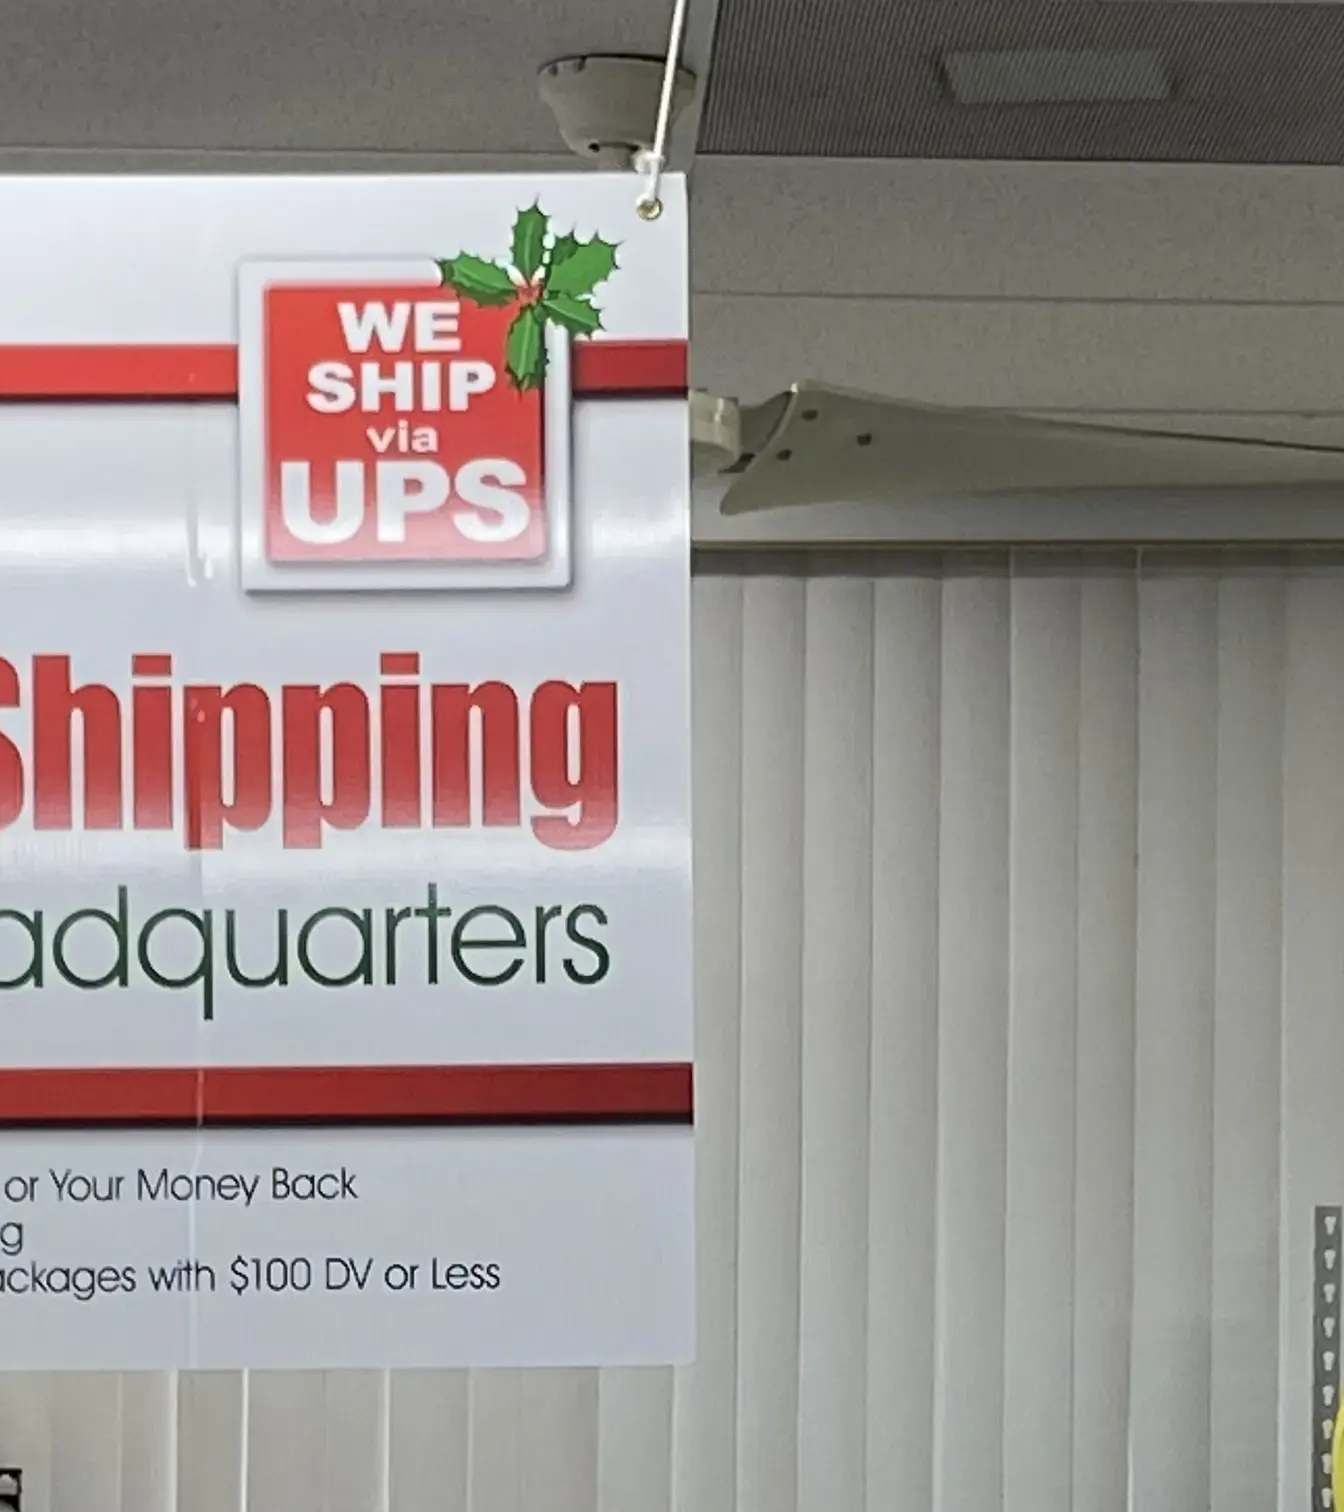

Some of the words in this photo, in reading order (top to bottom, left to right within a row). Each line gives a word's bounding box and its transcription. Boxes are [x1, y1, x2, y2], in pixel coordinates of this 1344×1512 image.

[337, 300, 462, 352] WE
[306, 360, 496, 413] SHIP
[367, 422, 439, 454] via
[279, 457, 530, 544] UPS
[5, 1176, 40, 1203] or
[50, 1168, 126, 1201] Your
[137, 1167, 260, 1206] Money
[272, 1167, 358, 1200] Back
[148, 1260, 216, 1292] with
[229, 1254, 312, 1296] $100
[325, 1257, 374, 1291] DV
[384, 1263, 420, 1291] or
[432, 1257, 501, 1290] Less
